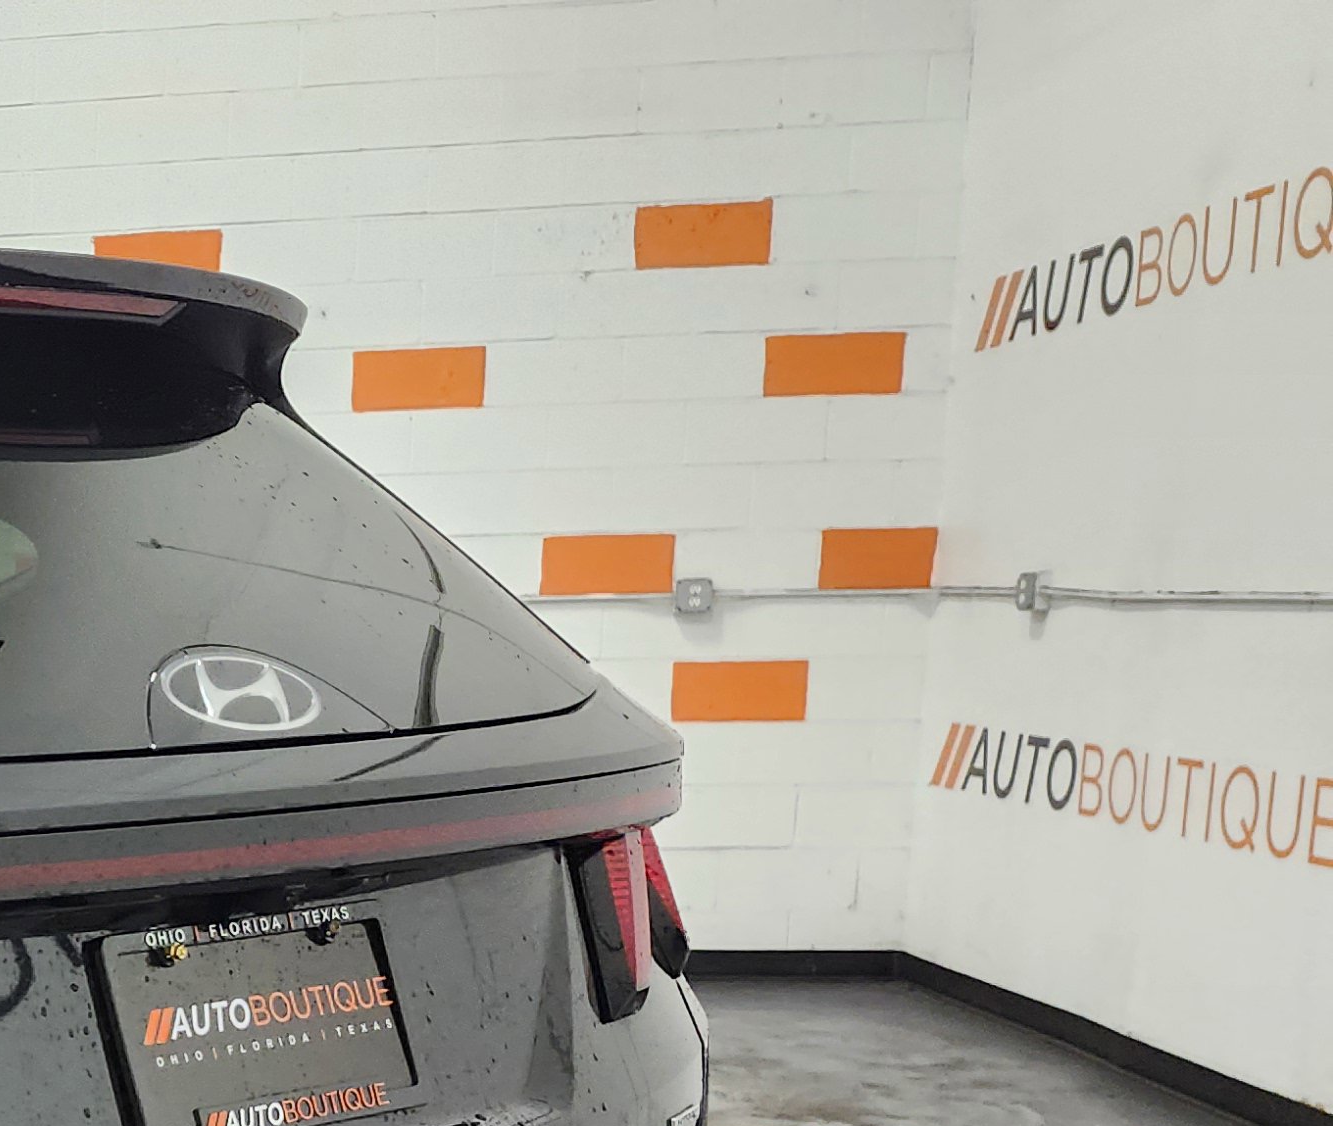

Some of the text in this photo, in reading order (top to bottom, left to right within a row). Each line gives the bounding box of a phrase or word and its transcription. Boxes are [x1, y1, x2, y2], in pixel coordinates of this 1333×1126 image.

[961, 726, 1333, 869] AUTOBOUTIQUE
[145, 906, 350, 947] OHIO FLORIDA TEXAS
[171, 975, 394, 1040] AUTOBOUTIQUE
[156, 1018, 394, 1068] OHIO FLORIDA TEXAS
